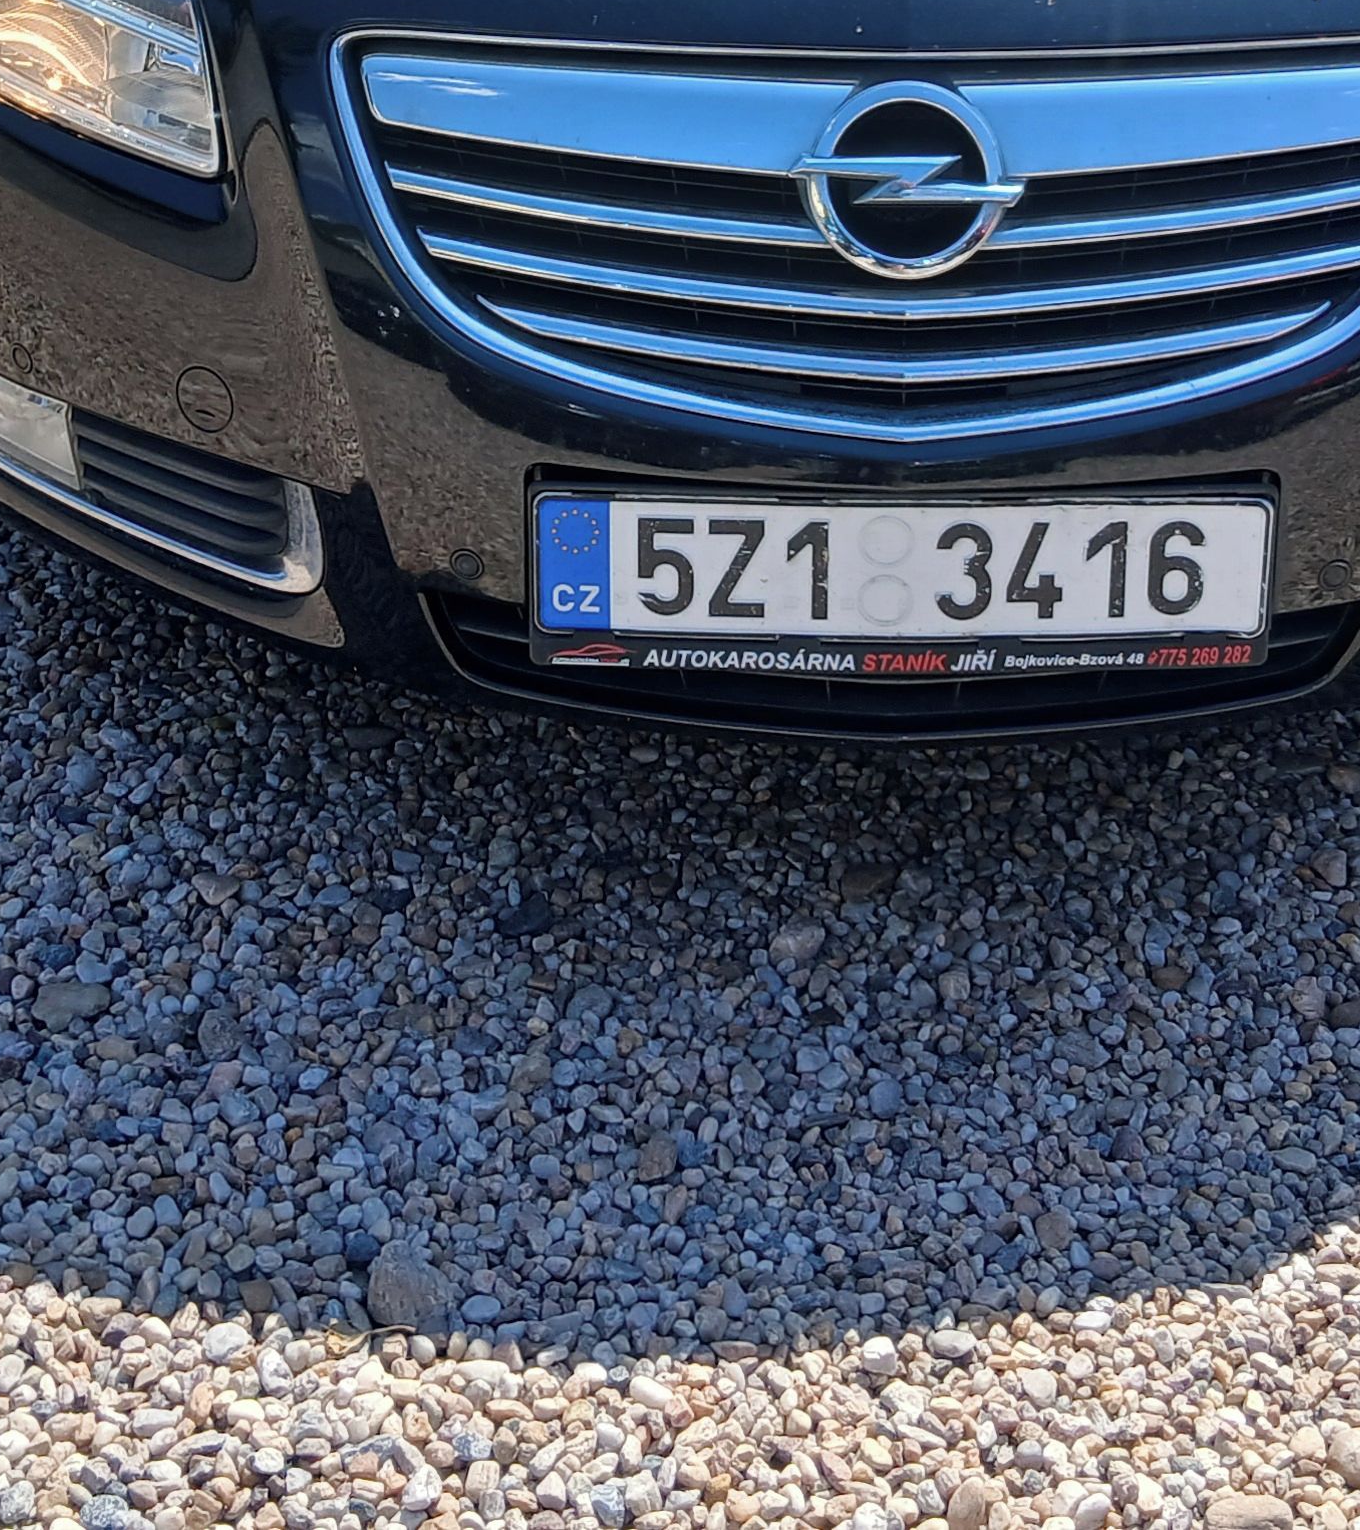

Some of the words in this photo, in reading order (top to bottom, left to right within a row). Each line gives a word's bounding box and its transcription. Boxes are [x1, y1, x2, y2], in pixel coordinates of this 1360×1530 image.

[637, 517, 829, 620] 5Z1
[935, 520, 1207, 620] 3416
[552, 584, 601, 613] CZ
[642, 648, 856, 671] AUTOKAROSÁRNA
[862, 649, 948, 672] STANÍK
[950, 648, 997, 671] JIŘÍ
[1126, 652, 1145, 665] 48
[1158, 648, 1187, 666] 775
[1191, 647, 1219, 666] 269
[1222, 644, 1252, 665] 282
